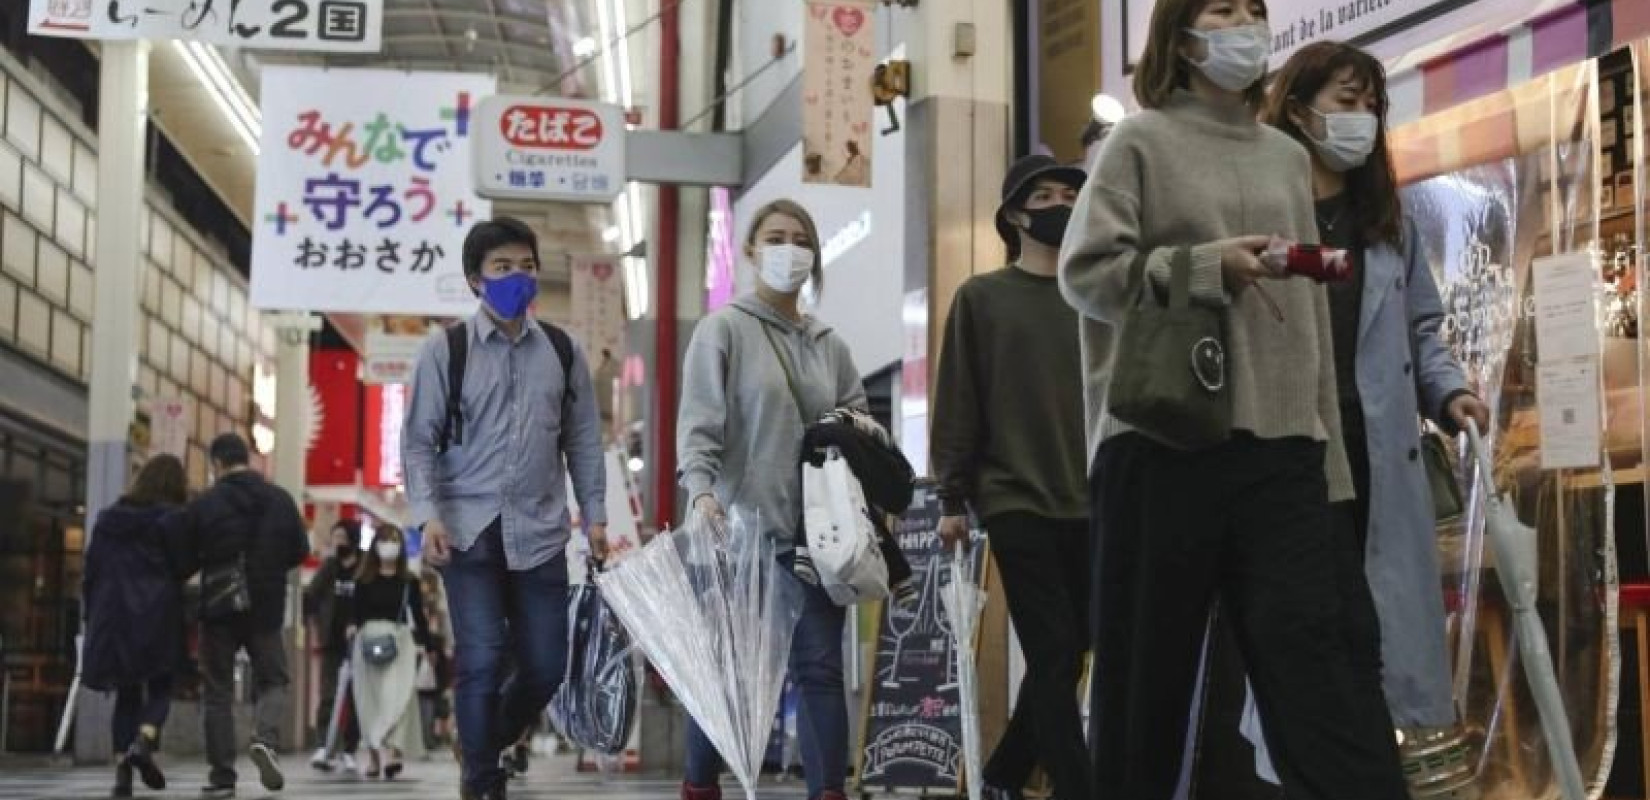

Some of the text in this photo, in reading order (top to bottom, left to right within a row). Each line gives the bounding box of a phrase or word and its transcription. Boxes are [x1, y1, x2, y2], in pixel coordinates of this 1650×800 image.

[287, 109, 452, 172] みんなで
[506, 109, 597, 144] たばこ
[504, 149, 598, 168] Cigarettes
[302, 172, 437, 231] 守ろう
[293, 236, 445, 274] おおさか
